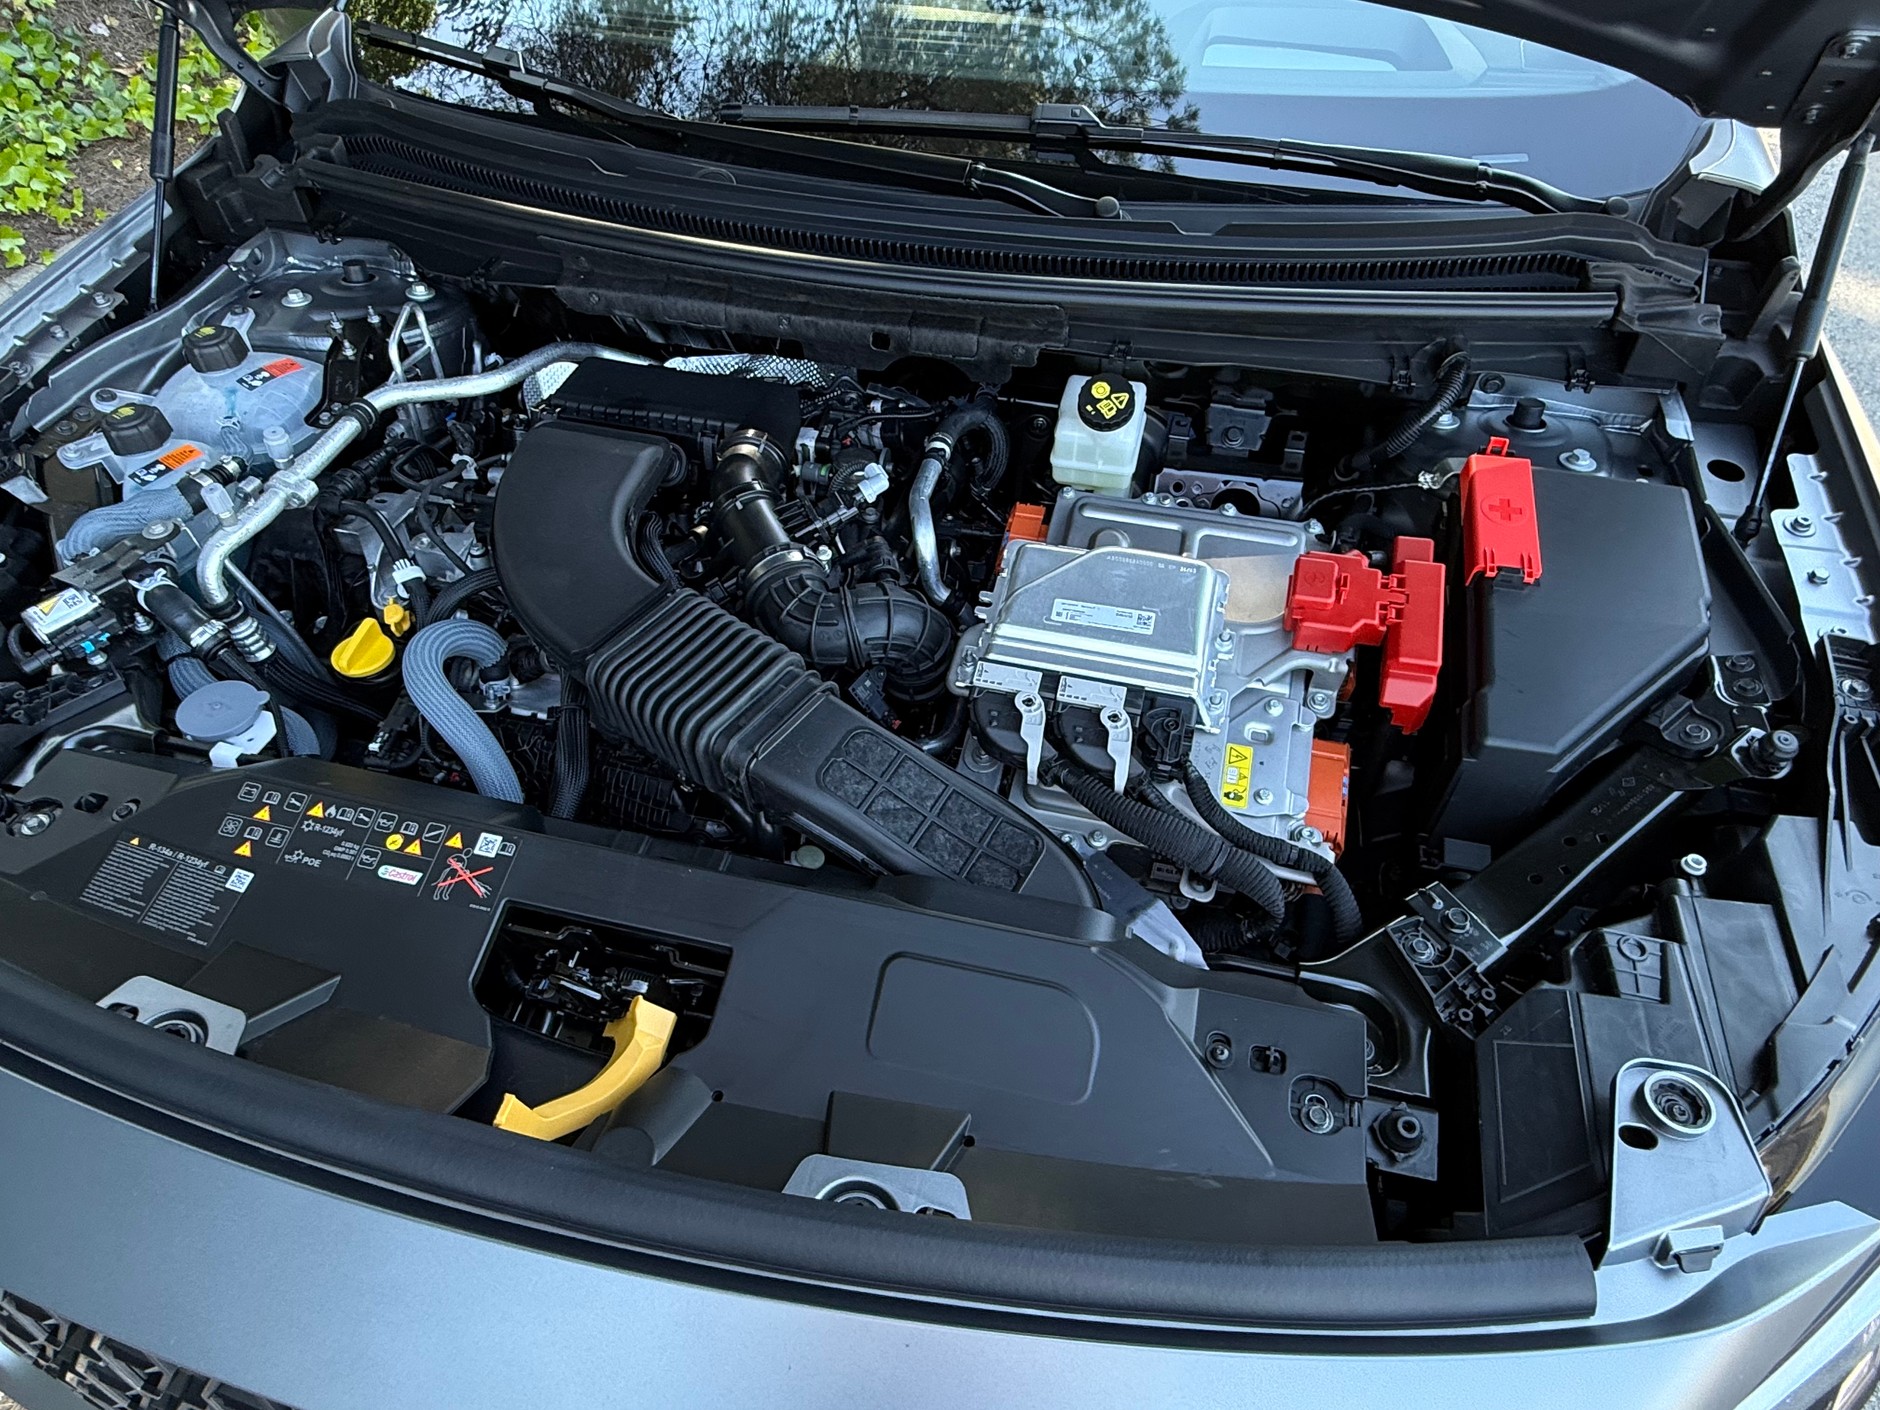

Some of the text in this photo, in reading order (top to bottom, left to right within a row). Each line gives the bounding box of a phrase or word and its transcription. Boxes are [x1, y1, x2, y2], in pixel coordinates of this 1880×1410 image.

[313, 823, 345, 838] R-1234yf
[301, 856, 322, 868] POE
[387, 868, 418, 882] Castrol
